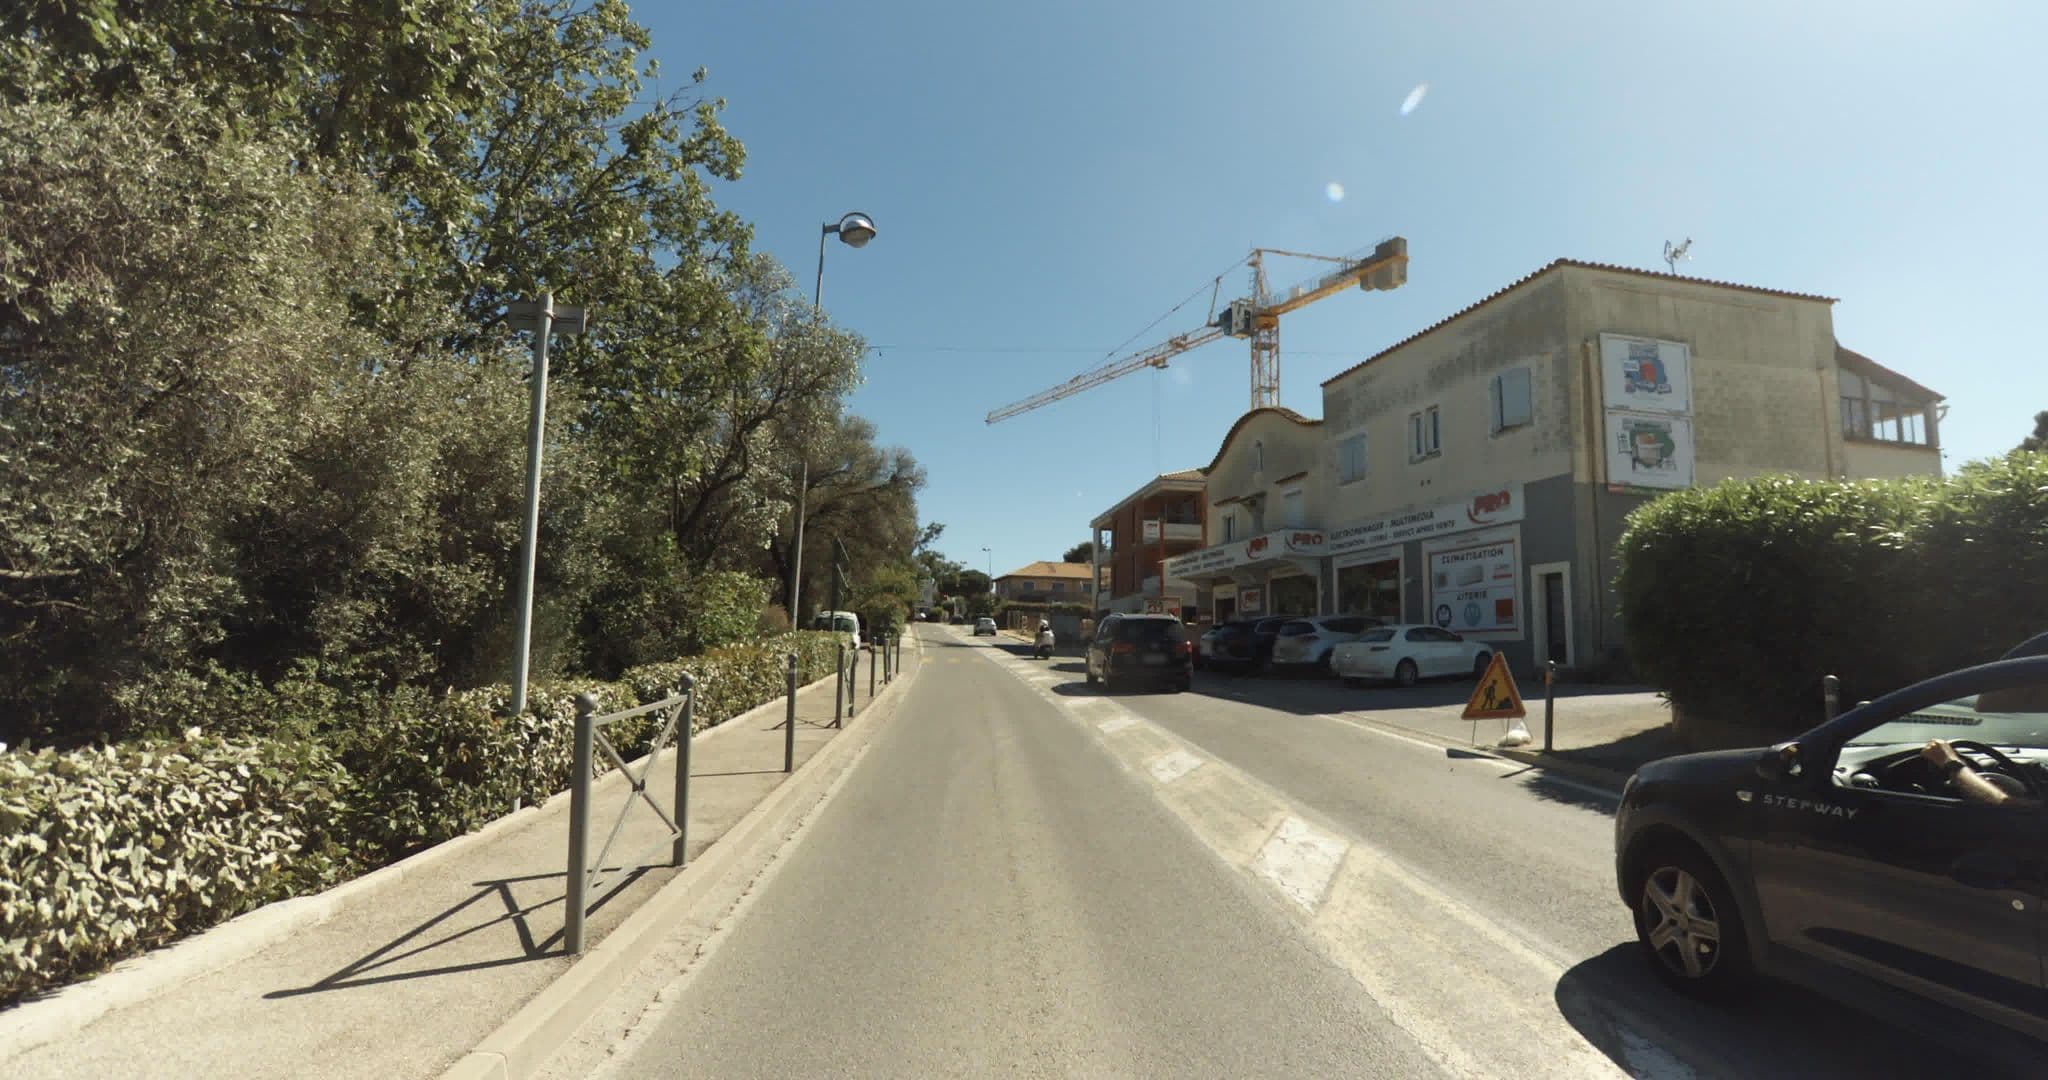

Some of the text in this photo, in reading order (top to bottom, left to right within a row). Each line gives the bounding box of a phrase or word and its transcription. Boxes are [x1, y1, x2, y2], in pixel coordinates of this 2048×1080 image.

[1293, 532, 1322, 545] PRO
[1442, 547, 1504, 564] CLIMATISATION
[1763, 793, 1858, 820] STEPWAY
